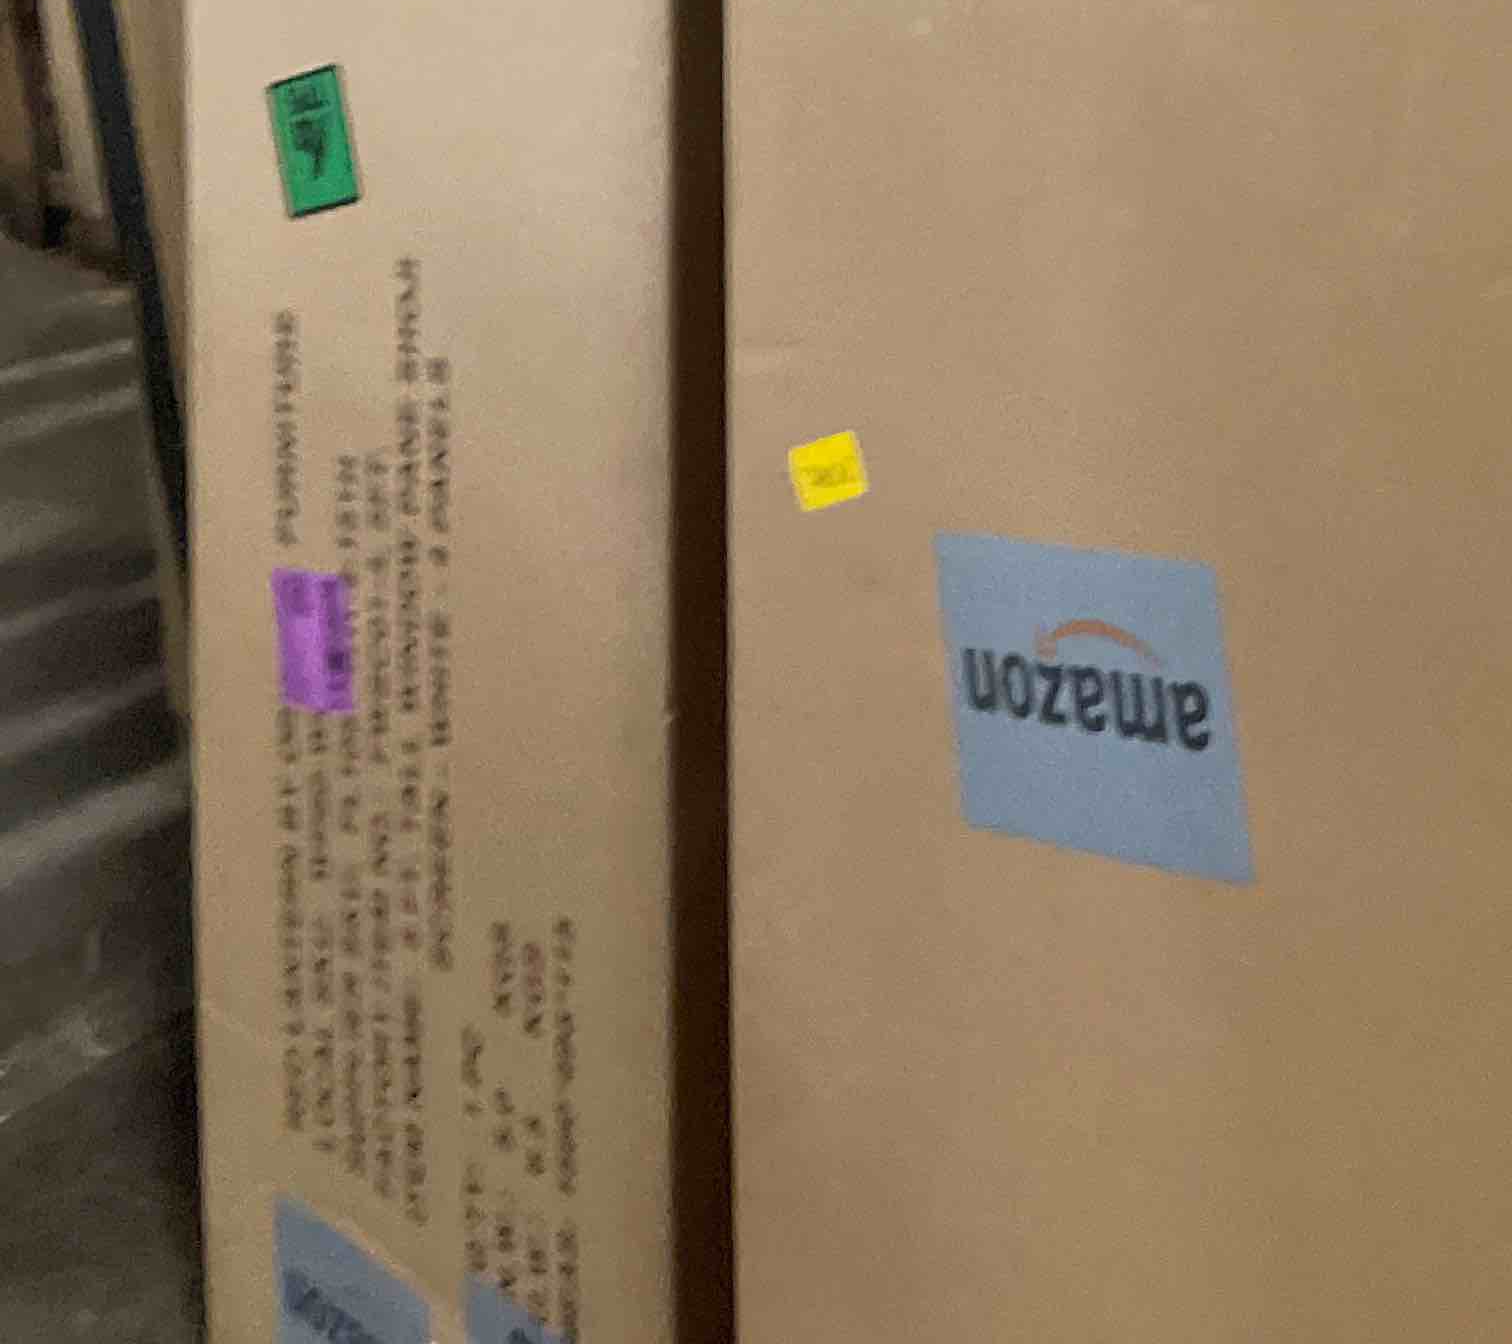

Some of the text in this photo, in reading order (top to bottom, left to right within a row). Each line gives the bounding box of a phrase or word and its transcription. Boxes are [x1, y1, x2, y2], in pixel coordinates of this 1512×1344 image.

[394, 256, 420, 385] SHOJI
[272, 309, 299, 548] FURNITURE
[395, 399, 420, 518] PANE
[425, 356, 451, 536] PANELS
[396, 530, 420, 714] WINDOW
[427, 612, 450, 748] WHITE
[962, 648, 1212, 753] amazon
